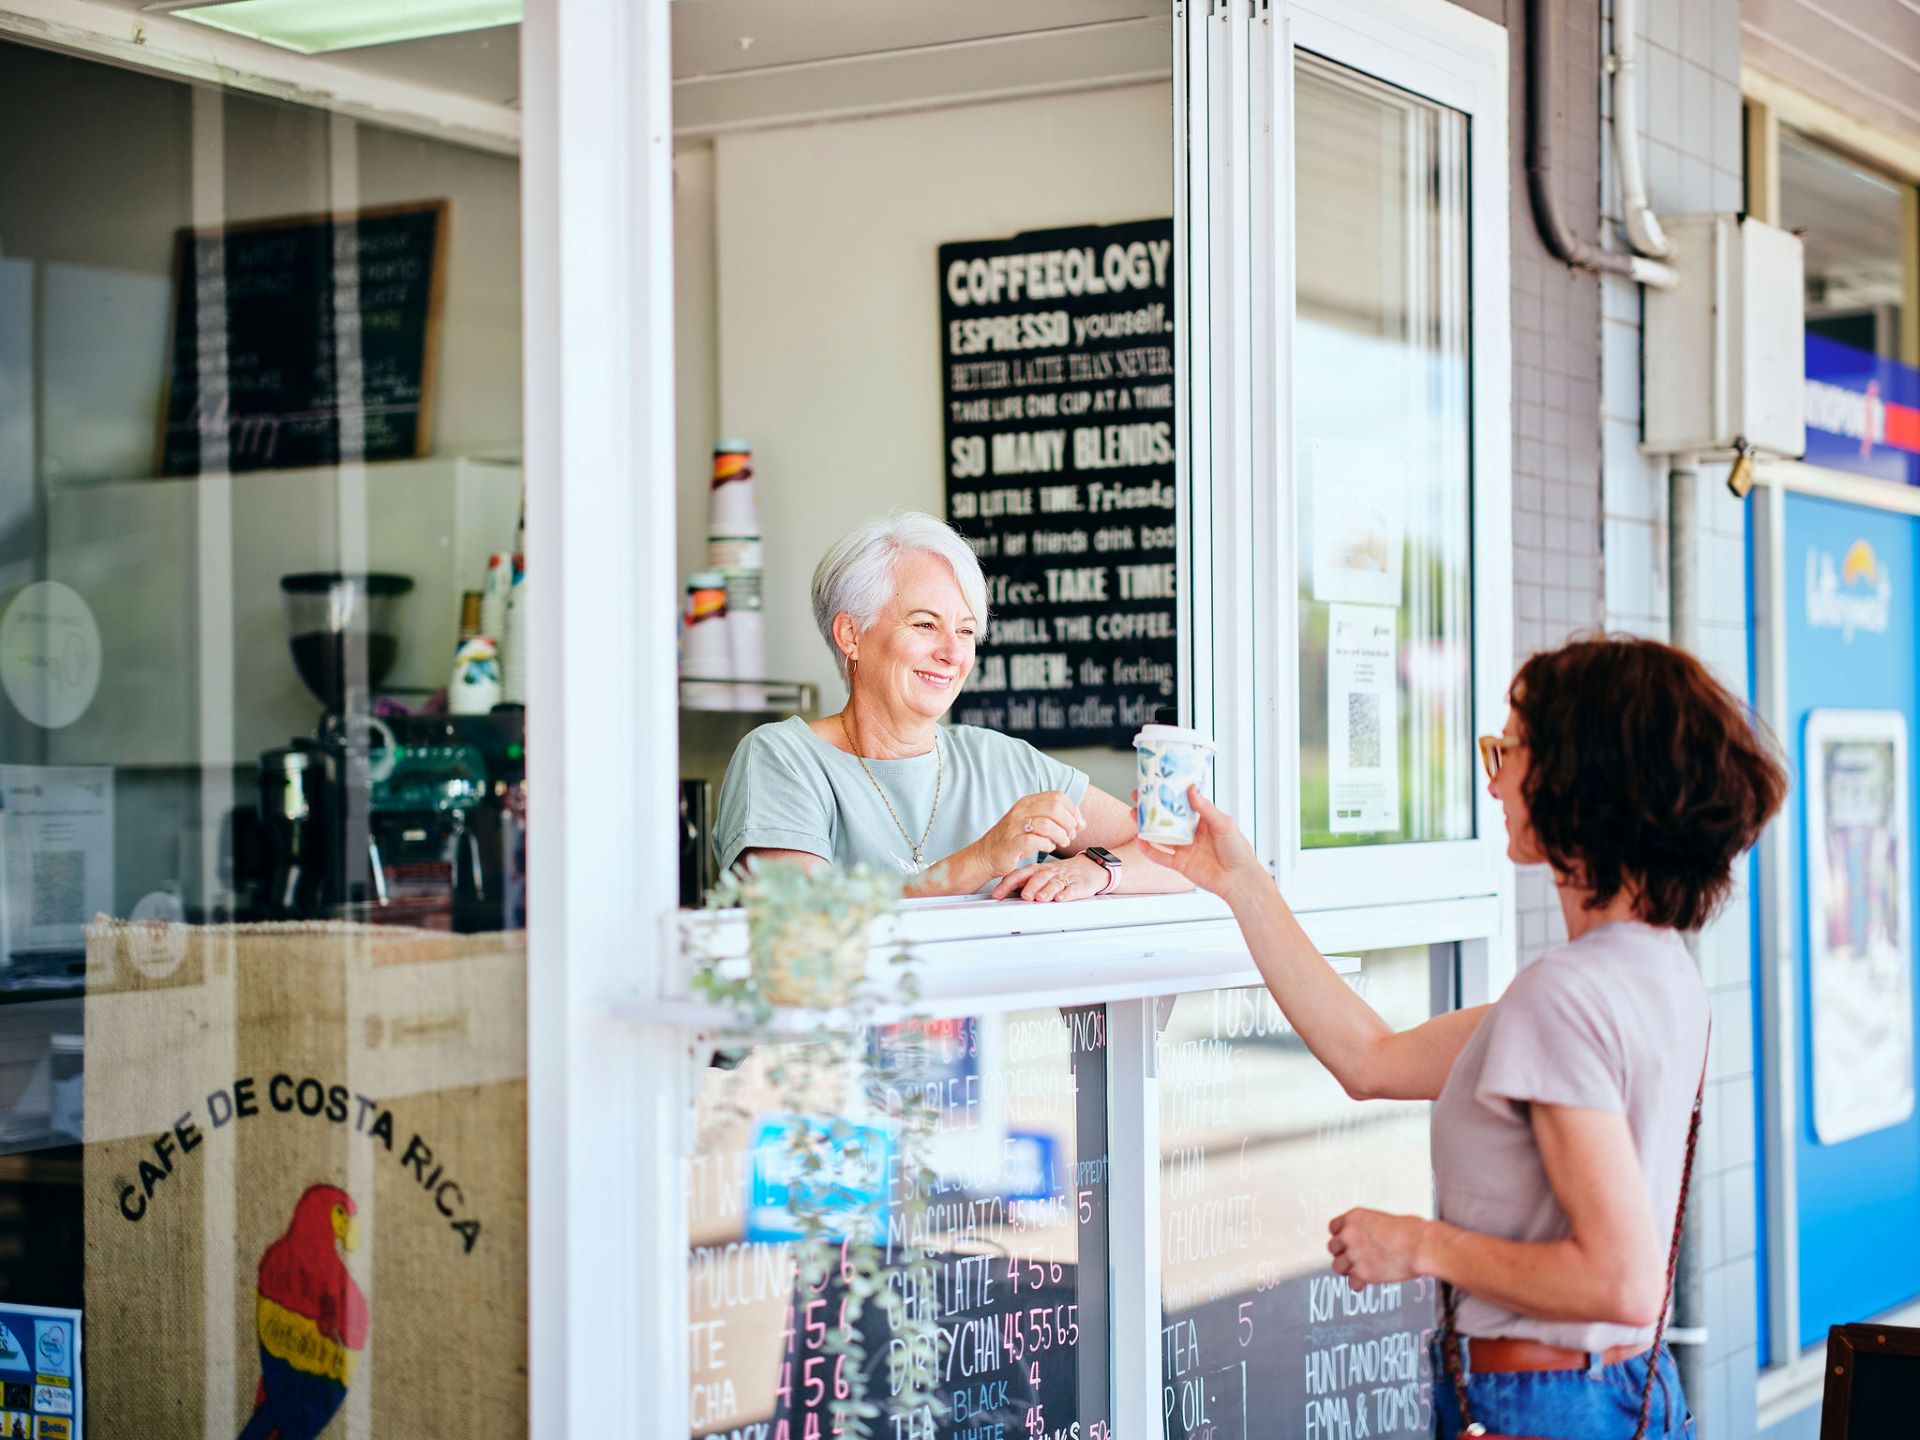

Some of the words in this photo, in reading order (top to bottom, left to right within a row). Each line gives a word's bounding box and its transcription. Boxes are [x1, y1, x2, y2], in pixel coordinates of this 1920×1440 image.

[947, 239, 1171, 306] COFFEEOLOGY
[950, 310, 1070, 355] ESPRESSO
[1072, 304, 1173, 346] yourself.
[951, 361, 1010, 392] BETTER
[1013, 354, 1066, 386] LATTE
[1067, 351, 1113, 381] THAN
[992, 395, 1024, 420] LIFE
[1026, 393, 1058, 417] ONE
[1059, 389, 1091, 415] CUP
[1093, 388, 1115, 412] AT
[1118, 388, 1132, 411] A
[1133, 383, 1173, 408] TIME
[951, 435, 985, 478] SO
[992, 429, 1066, 475] MANY
[1073, 421, 1174, 470] BLENDS.
[951, 492, 978, 518] SO
[979, 488, 1034, 517] LITTLE
[1032, 529, 1088, 555] friends
[1094, 525, 1136, 551] drink
[1141, 523, 1175, 549] bad
[1044, 567, 1110, 602] TAKE
[1116, 563, 1175, 600] TIME
[991, 616, 1051, 645] SMELL
[1053, 616, 1092, 641] THE
[1096, 612, 1175, 641] COFFEE.
[1010, 652, 1074, 690] BREW:
[1079, 657, 1107, 686] the
[1112, 656, 1174, 696] feeling
[1068, 695, 1115, 727] coffee
[117, 1110, 204, 1223] CAFE
[206, 1077, 260, 1130] DE
[268, 1073, 394, 1152] COSTA
[400, 1133, 482, 1255] RICA
[1170, 1144, 1205, 1200] CHAI
[886, 1196, 1002, 1265] MACCHIATO
[1078, 1191, 1093, 1224] 5
[1167, 1195, 1250, 1265] CHOCOLATE
[945, 1253, 996, 1316] LATTE
[1007, 1249, 1020, 1295] 4
[1028, 1244, 1046, 1290] 5
[1049, 1240, 1063, 1283] 6
[805, 1299, 827, 1350] 5
[1161, 1318, 1200, 1380] TEA
[1238, 1301, 1254, 1349] 5
[775, 1361, 793, 1409] 4
[803, 1355, 826, 1408] 5
[833, 1353, 849, 1400] 6
[953, 1379, 1010, 1423] BLACK
[1029, 1360, 1042, 1391] 4
[1306, 1396, 1353, 1440] EMMA
[1355, 1391, 1371, 1440] &
[1419, 1382, 1432, 1432] 5
